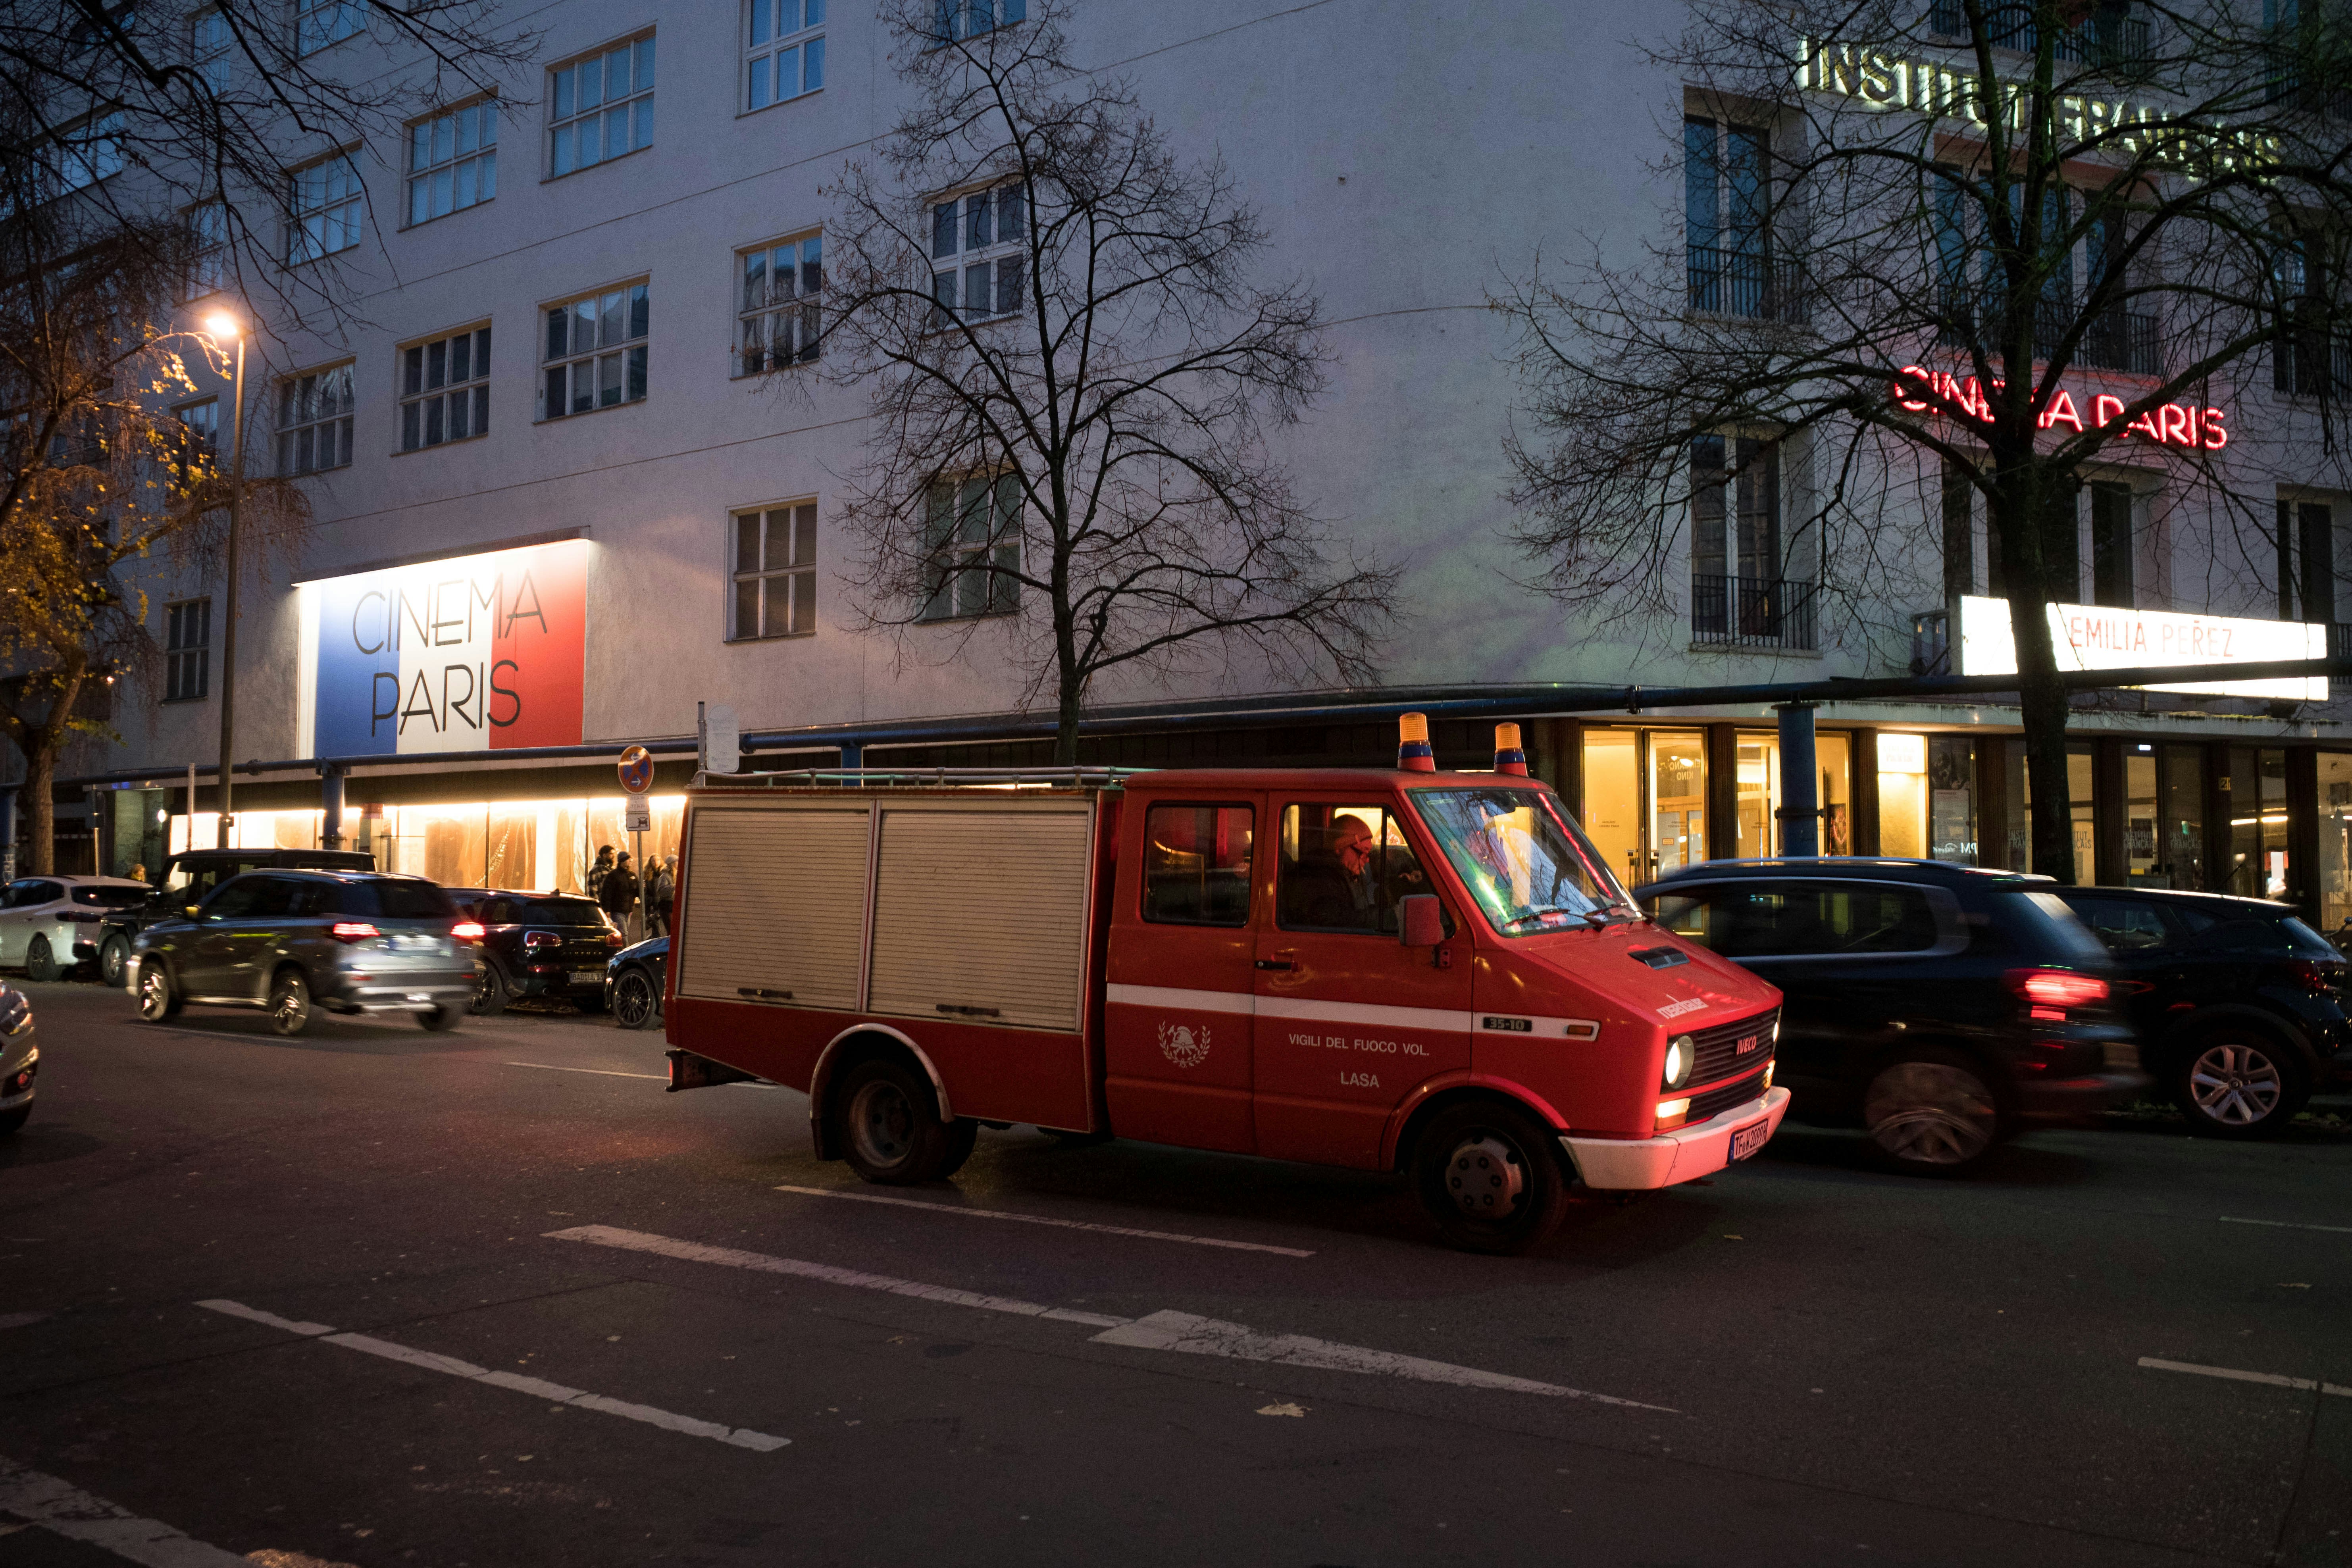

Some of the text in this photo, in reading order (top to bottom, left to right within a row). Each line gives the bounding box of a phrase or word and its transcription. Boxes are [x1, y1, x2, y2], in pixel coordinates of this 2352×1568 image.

[1895, 366, 2083, 432] CINA
[352, 568, 548, 654] CINEMA
[2071, 617, 2147, 652] EMILIA
[371, 660, 521, 737] PARIS
[1489, 1018, 1525, 1030] 35-10
[1289, 1033, 1430, 1056] VIGILI DEL FUOCO VOL.
[1737, 1036, 1757, 1055] IVECO
[1340, 1071, 1380, 1088] LASA
